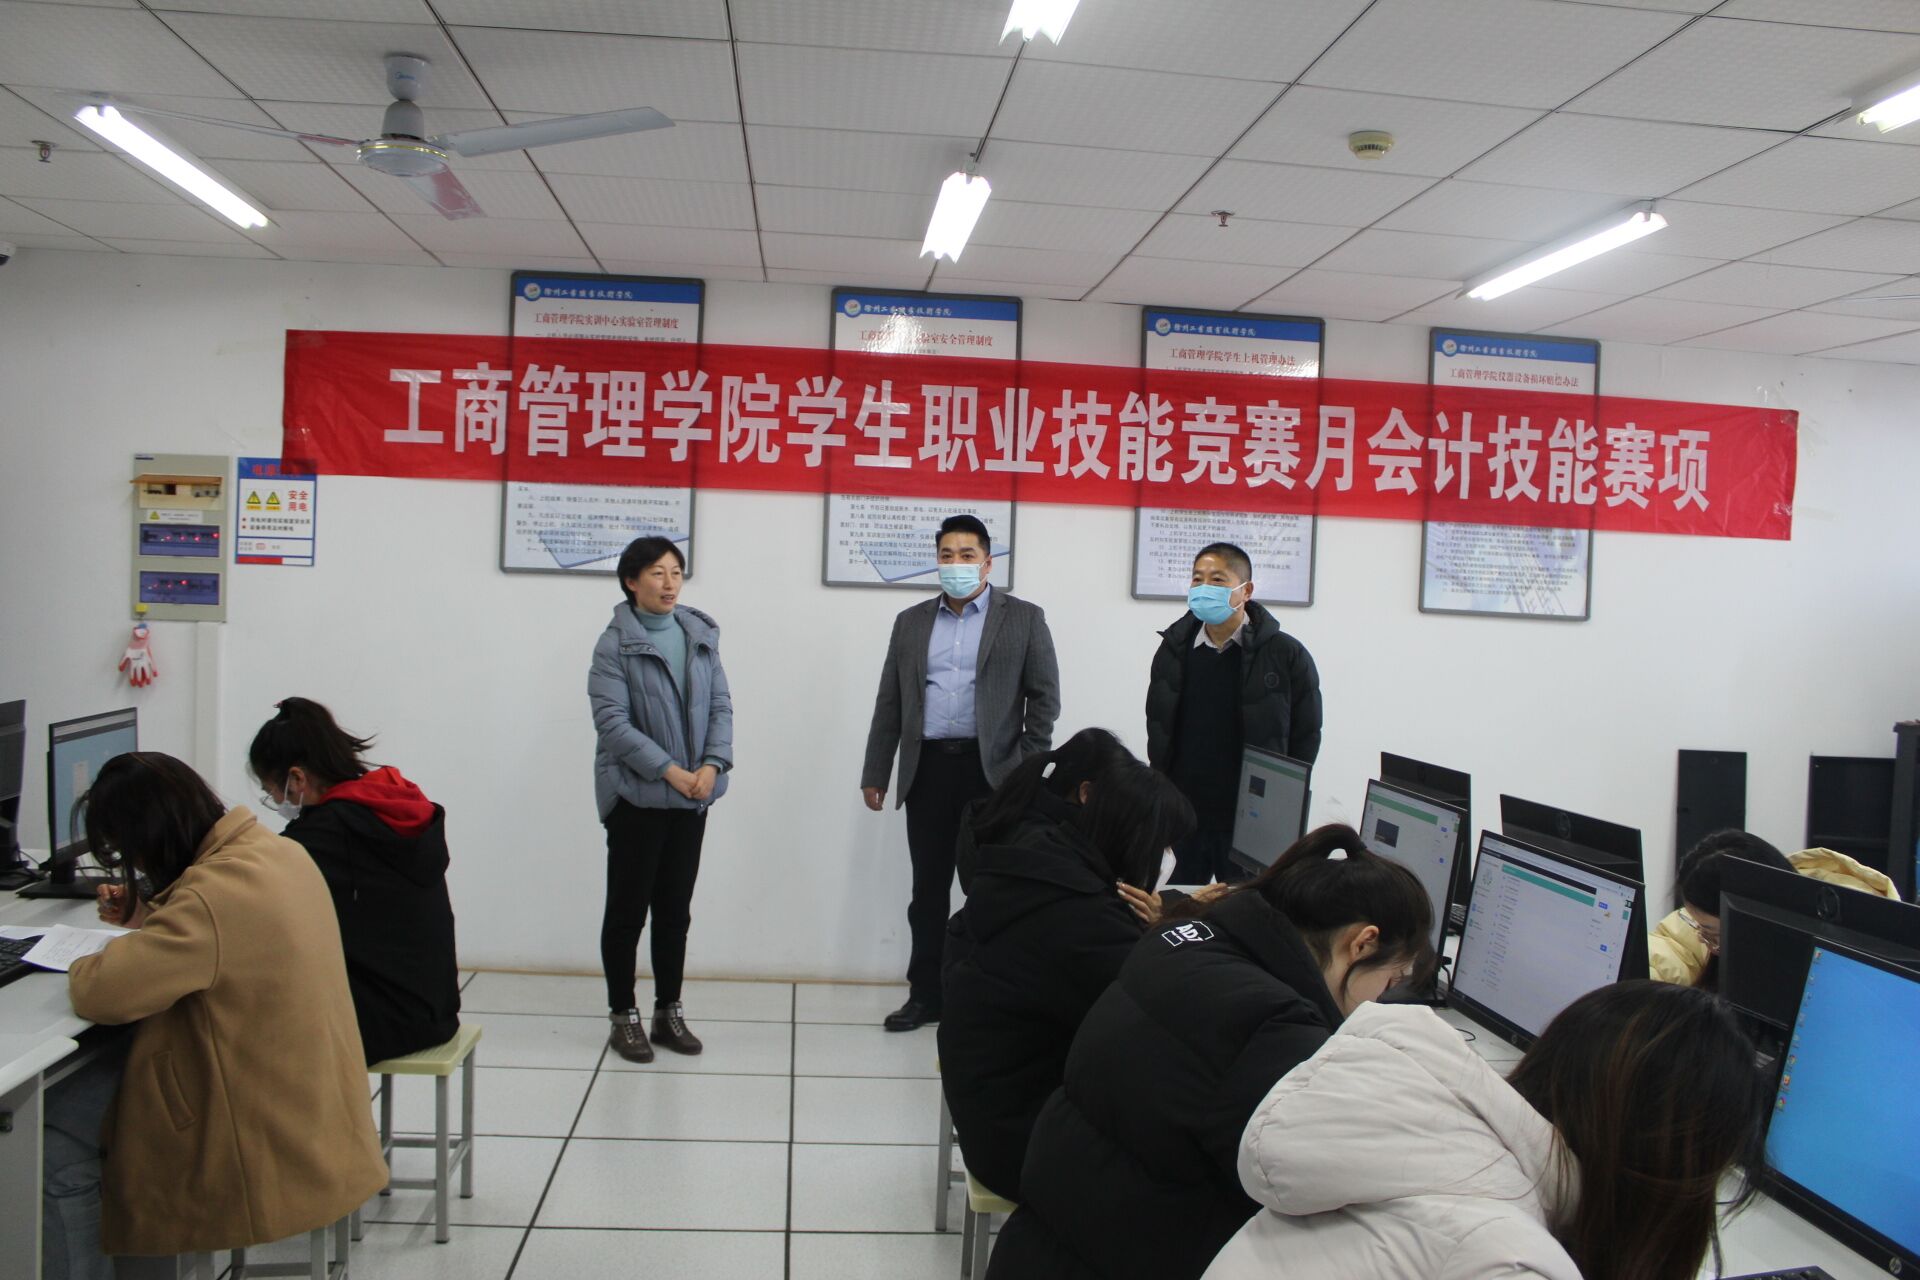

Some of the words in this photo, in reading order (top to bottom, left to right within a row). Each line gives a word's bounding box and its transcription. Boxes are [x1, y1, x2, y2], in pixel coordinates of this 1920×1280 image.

[535, 312, 680, 330] 工商管理学院实训中心实验室管理制度
[1169, 347, 1296, 366] 工商管理学院学生上机管理办法
[383, 361, 1711, 513] 工商管理学院学生职业技能竞赛月会计技能赛项
[288, 490, 309, 501] 安全
